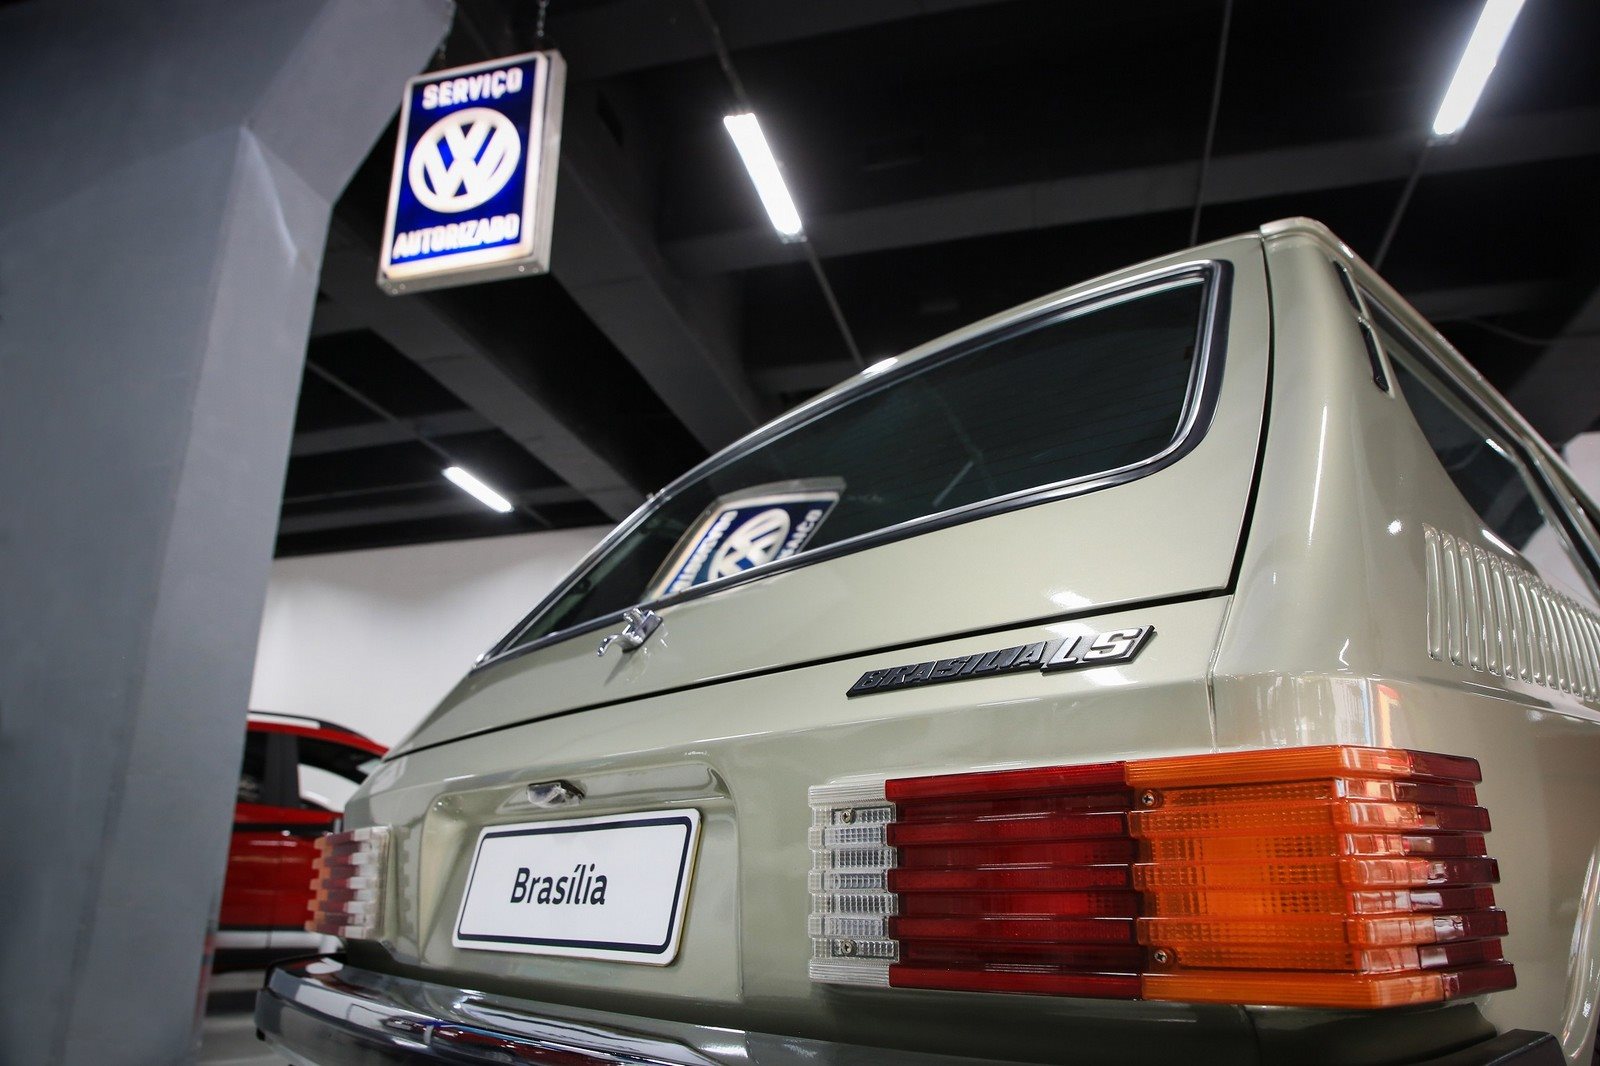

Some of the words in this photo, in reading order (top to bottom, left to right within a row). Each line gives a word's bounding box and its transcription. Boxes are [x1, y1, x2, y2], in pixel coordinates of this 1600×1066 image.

[422, 67, 523, 110] SERVIÇO
[412, 110, 518, 209] VW
[392, 213, 520, 259] AUTORIZADO
[850, 640, 1047, 691] BRASILIA
[1047, 627, 1143, 667] LS
[510, 863, 608, 906] Brasília
